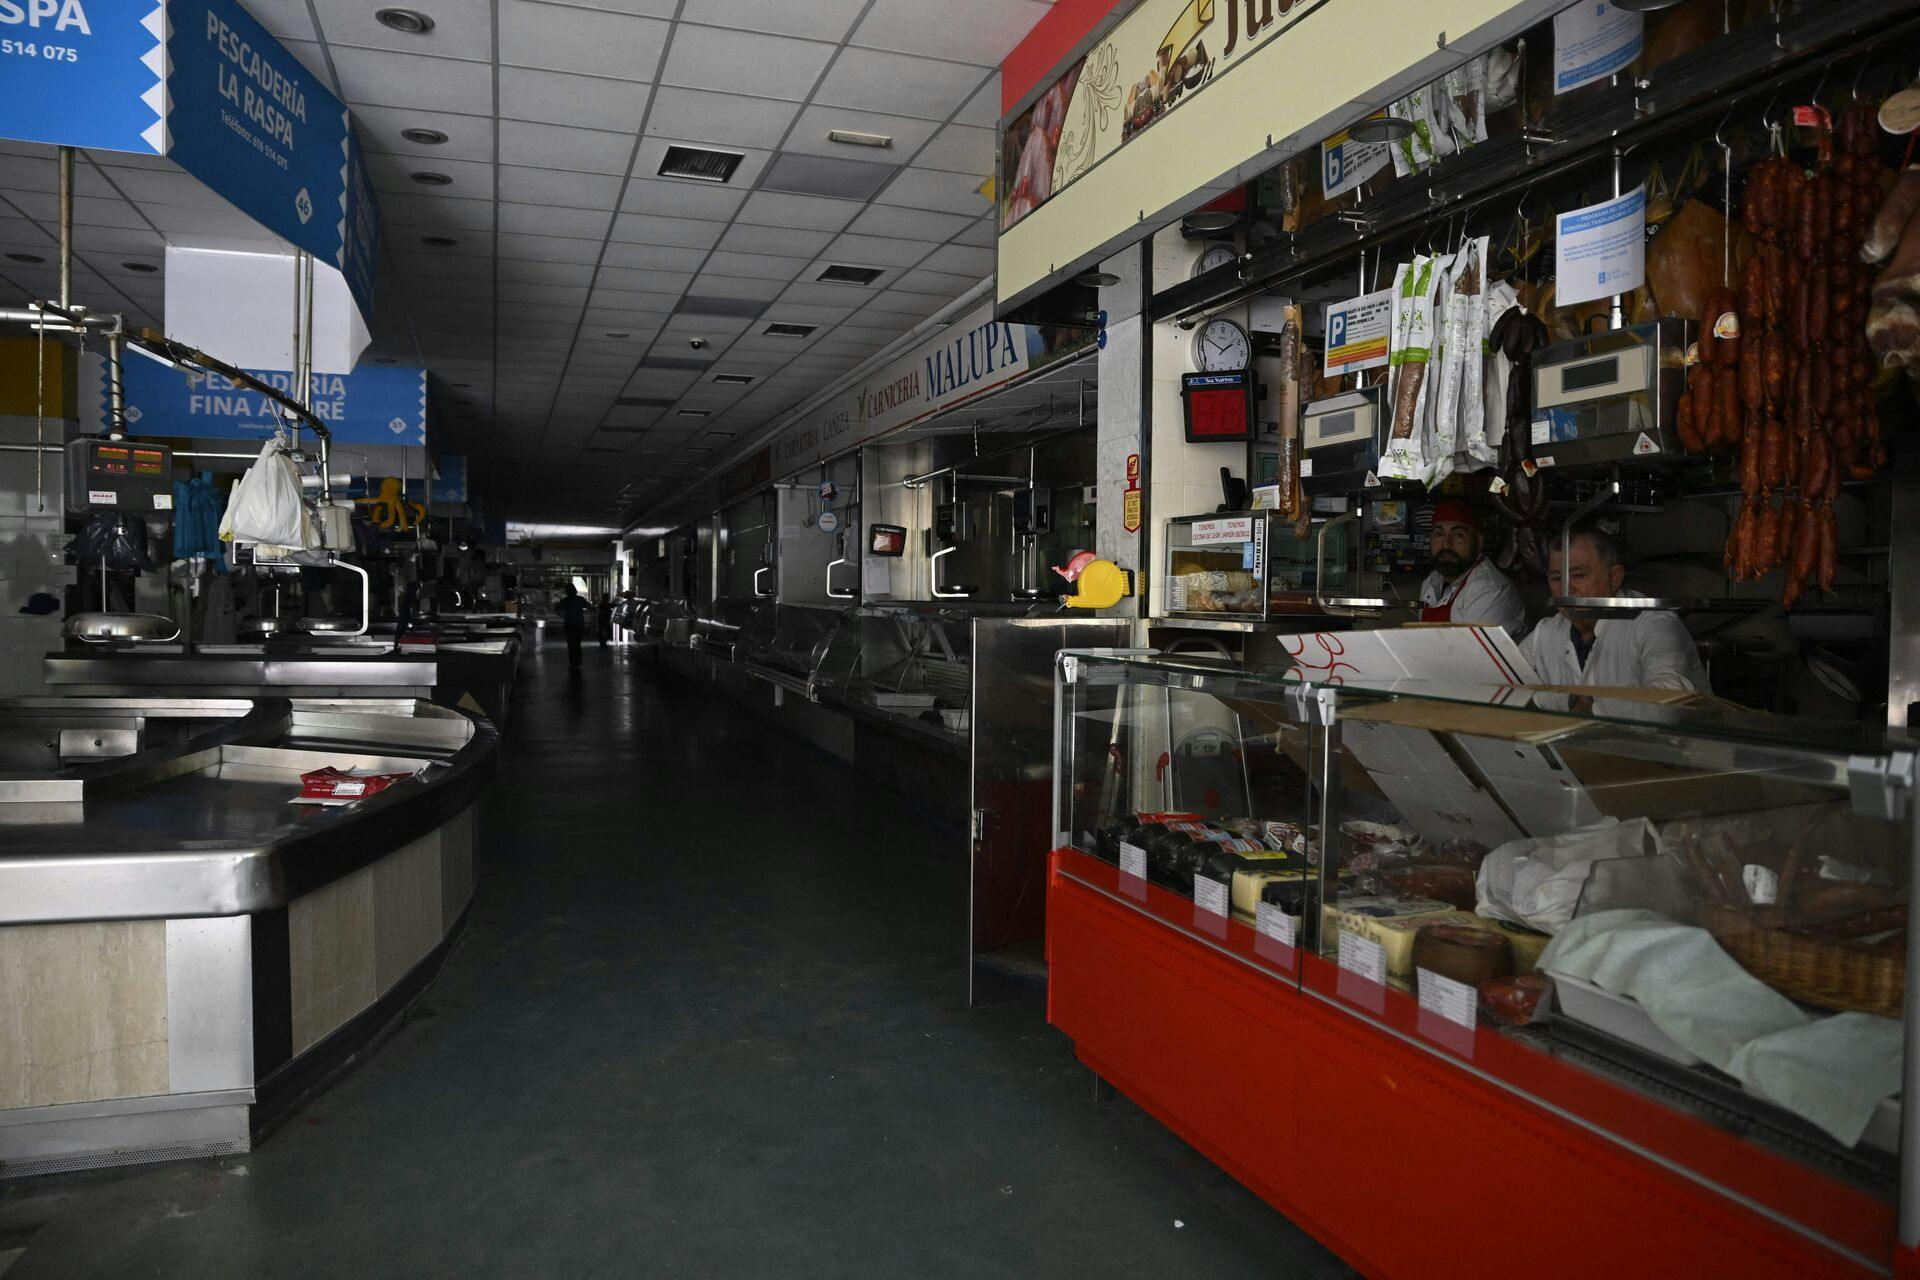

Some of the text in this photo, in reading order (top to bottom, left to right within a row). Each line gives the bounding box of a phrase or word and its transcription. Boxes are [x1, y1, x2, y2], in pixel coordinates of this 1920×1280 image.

[1, 39, 78, 62] 514 075
[207, 8, 306, 124] PESCADERÍA
[218, 62, 293, 151] LA RASPA
[1331, 315, 1345, 346] P
[926, 321, 1018, 401] MALUPA
[190, 395, 252, 417] FINA
[868, 370, 920, 418] CARNICERIA
